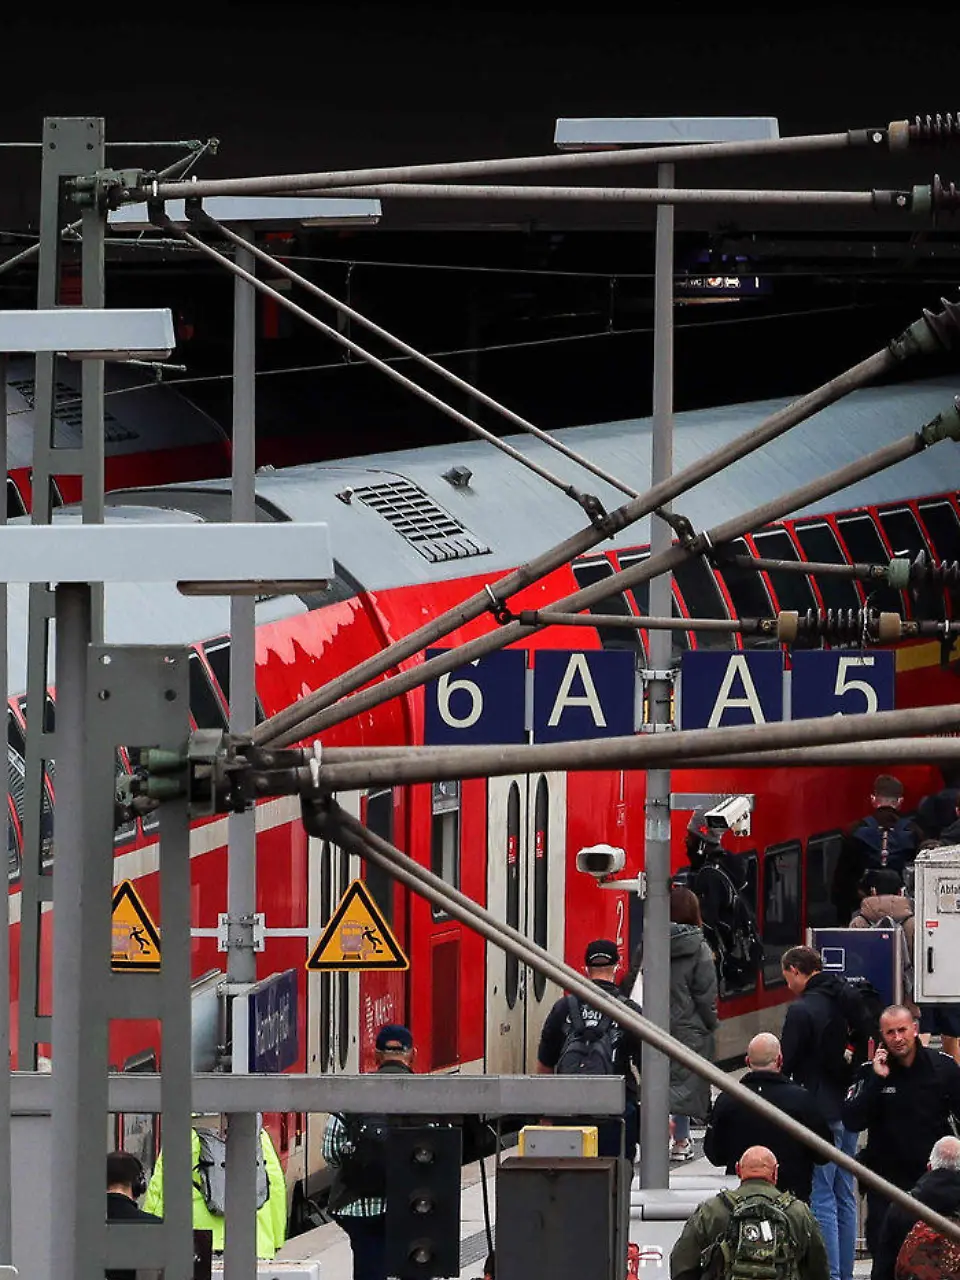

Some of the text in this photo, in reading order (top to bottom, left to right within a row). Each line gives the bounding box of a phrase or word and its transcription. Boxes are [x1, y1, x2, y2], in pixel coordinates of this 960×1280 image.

[436, 653, 607, 729] 6 A
[707, 655, 879, 728] A 5
